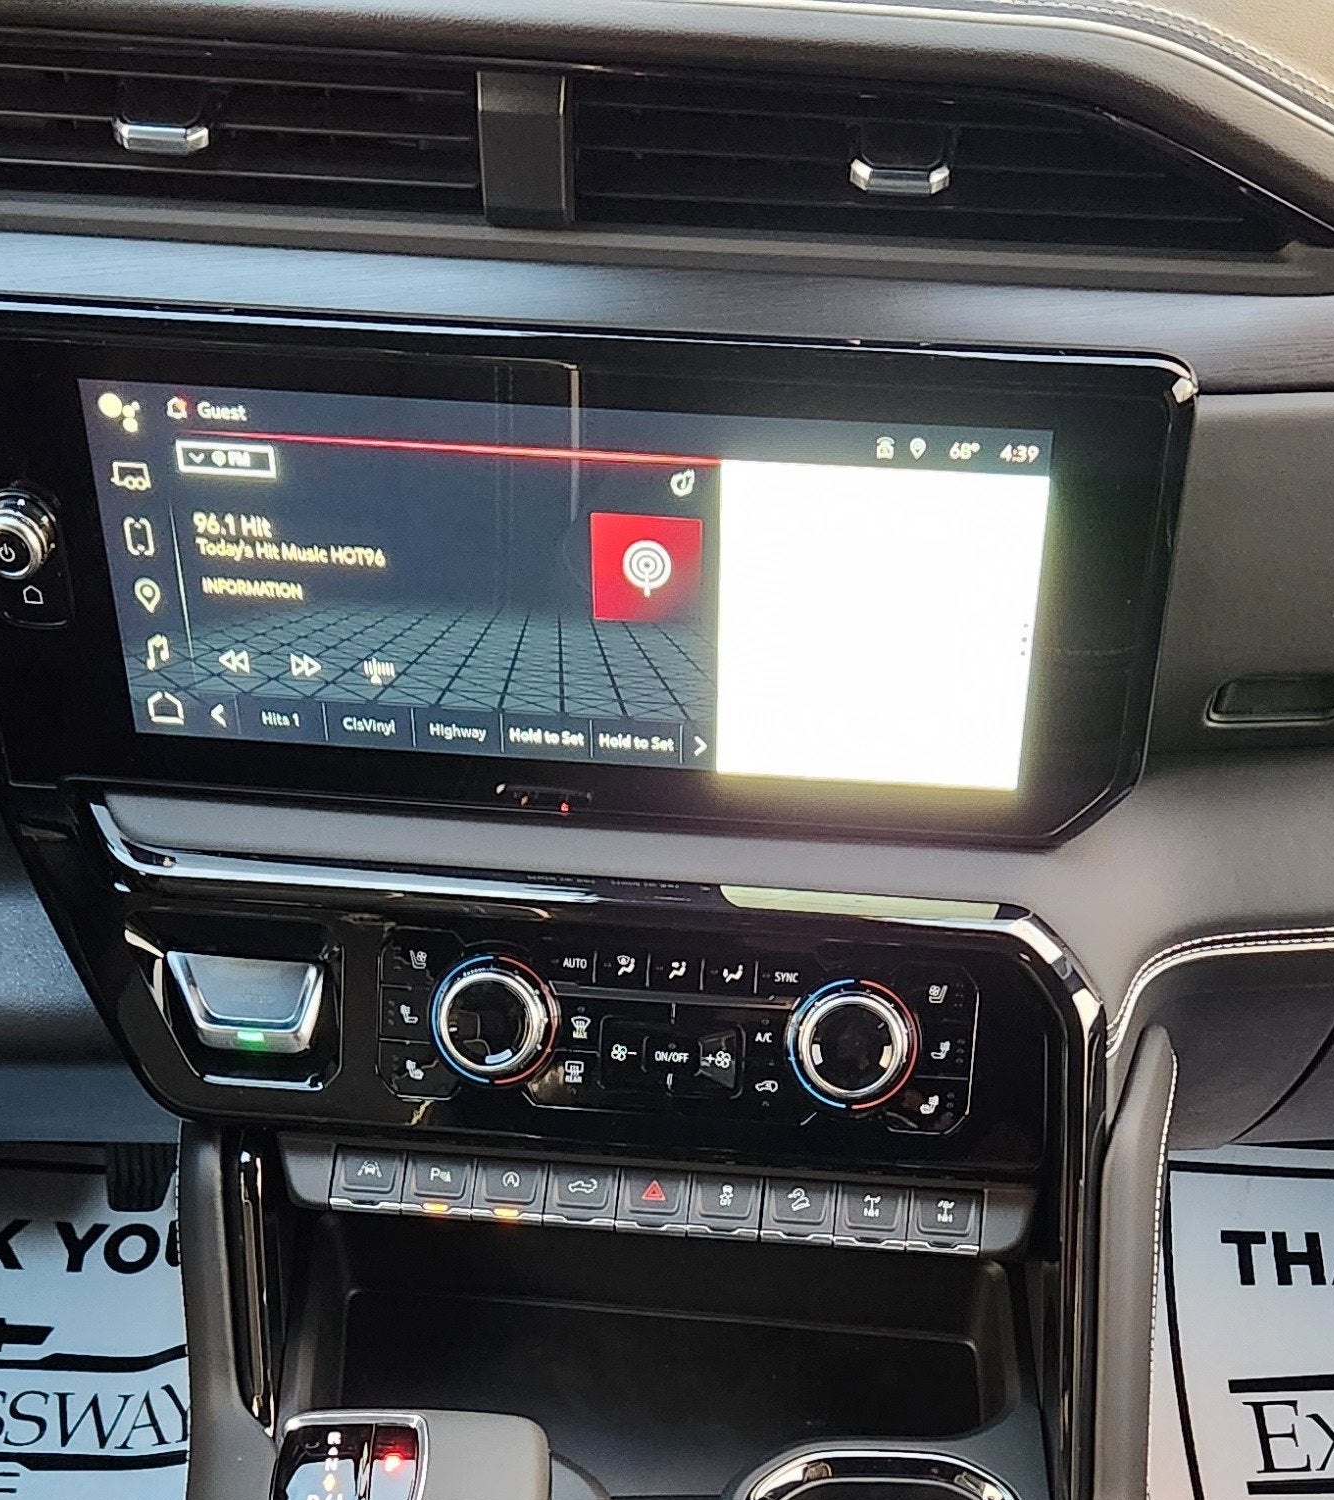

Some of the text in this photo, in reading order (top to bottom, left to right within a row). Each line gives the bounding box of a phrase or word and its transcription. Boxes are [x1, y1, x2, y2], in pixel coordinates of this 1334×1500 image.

[197, 401, 248, 421] Guest
[1000, 443, 1040, 463] 4:39
[192, 511, 272, 538] 96.1 Hit
[195, 536, 387, 568] Today's Hit Music HOT96
[201, 577, 304, 600] INFORMATION
[261, 711, 300, 728] Hits 1
[429, 722, 486, 742] Highway
[509, 726, 585, 747] Hold to Set
[598, 732, 675, 752] Hold to Set
[563, 957, 587, 970] AUTO
[774, 971, 800, 983] SYNC
[755, 1031, 773, 1043] A/C
[655, 1051, 689, 1063] ON/OFF
[55, 1219, 182, 1275] YO
[325, 1457, 339, 1472] N
